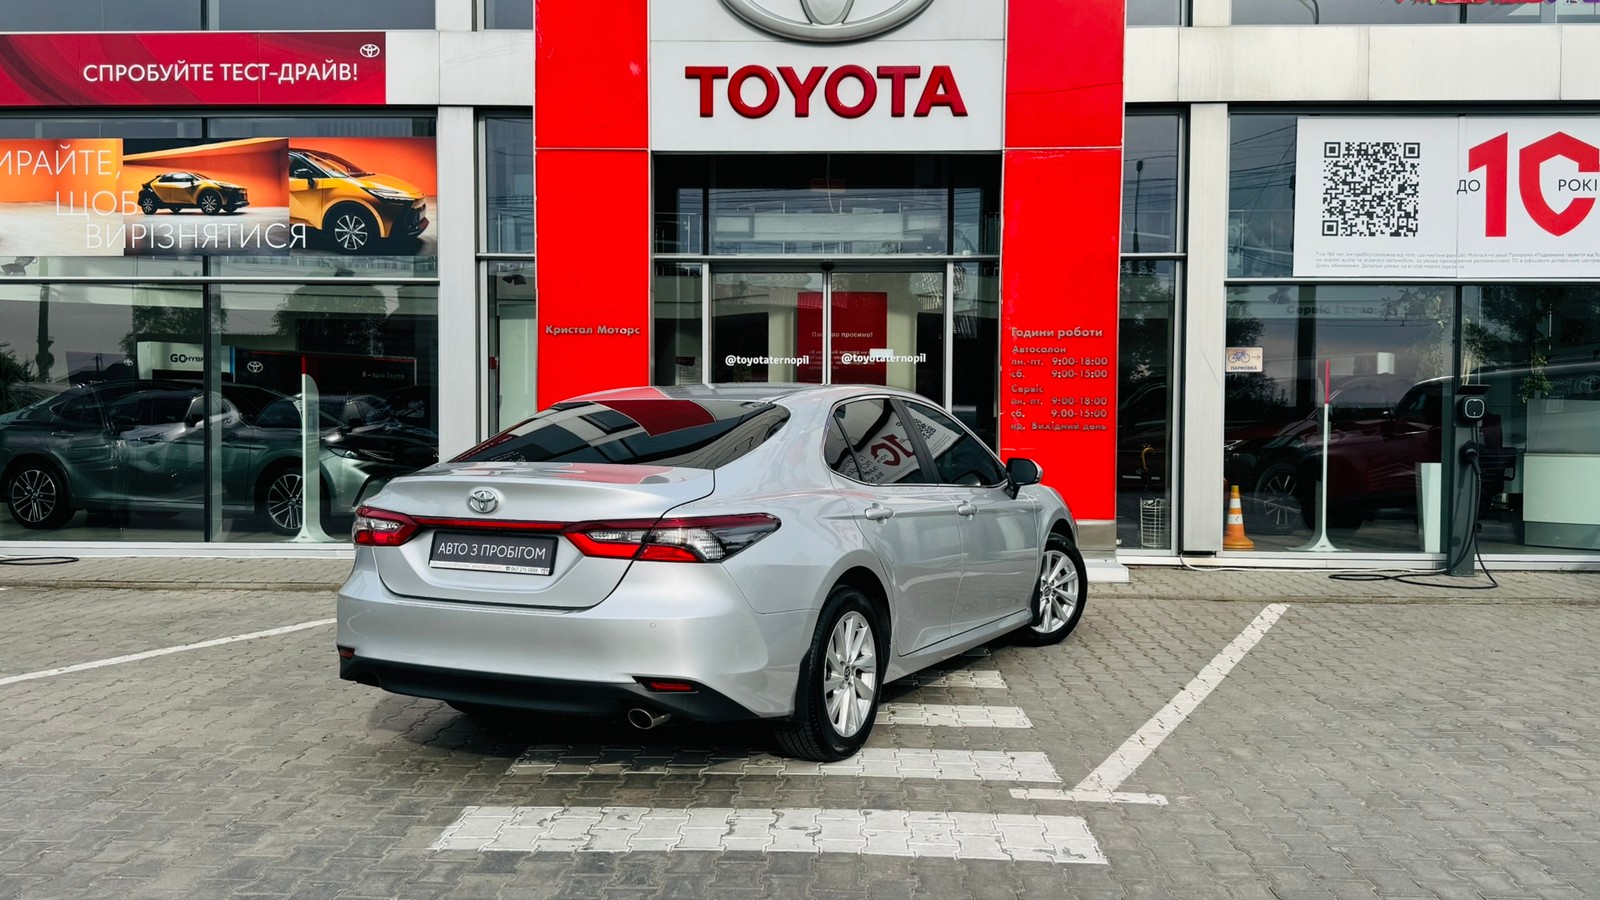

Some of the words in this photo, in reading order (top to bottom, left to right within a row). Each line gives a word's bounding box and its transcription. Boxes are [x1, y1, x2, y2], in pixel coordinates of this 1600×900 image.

[83, 60, 213, 83] СПРОБУЙТЕ
[220, 59, 358, 85] ТЕСТ-ДРАЙВ!
[685, 64, 968, 119] TOYOTA
[1456, 179, 1481, 195] ДО
[56, 190, 138, 219] ЩОБ
[86, 223, 307, 249] ВИРІЗНЯТИСЯ
[545, 325, 593, 336] Кристал
[597, 325, 640, 336] Моторс
[1011, 327, 1055, 339] Години
[1057, 327, 1103, 339] роботи
[1011, 345, 1067, 354] Автосалон
[725, 355, 810, 367] @toyotaternopil
[841, 353, 927, 364] @toyotaternopil
[1011, 369, 1026, 378] сб.
[1010, 408, 1026, 418] сб.
[437, 542, 468, 556] АВТО
[480, 543, 546, 560] ПРОБІГОМ
